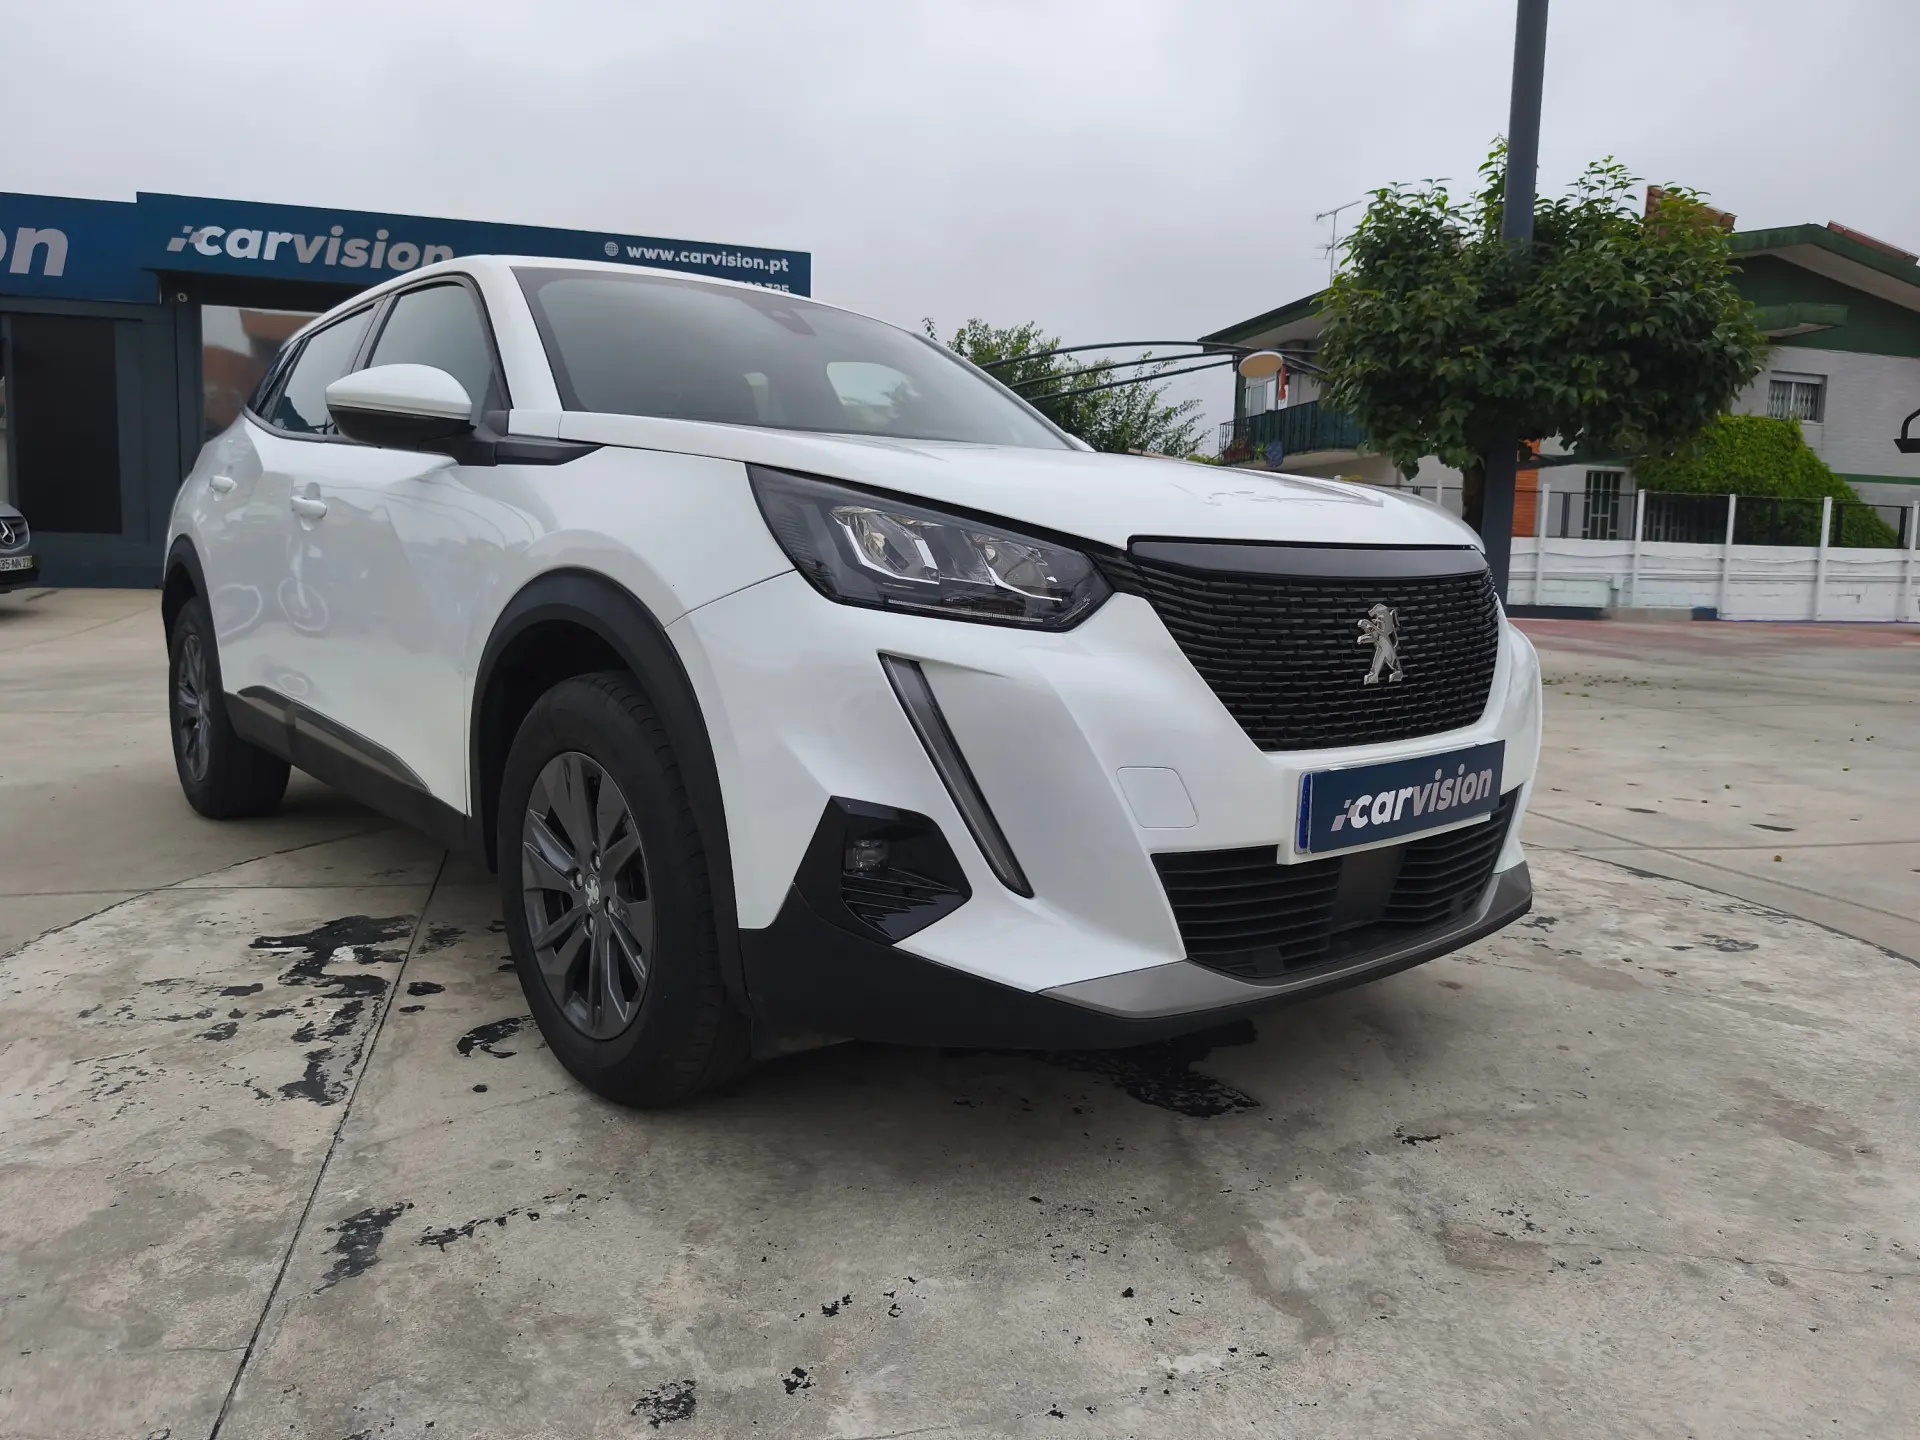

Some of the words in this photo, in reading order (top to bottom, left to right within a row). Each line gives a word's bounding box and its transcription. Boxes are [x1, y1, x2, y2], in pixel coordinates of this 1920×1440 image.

[0, 227, 68, 277] n
[193, 225, 454, 271] carvision
[627, 246, 789, 274] www.carvision.pt
[1350, 764, 1492, 828] carvision
